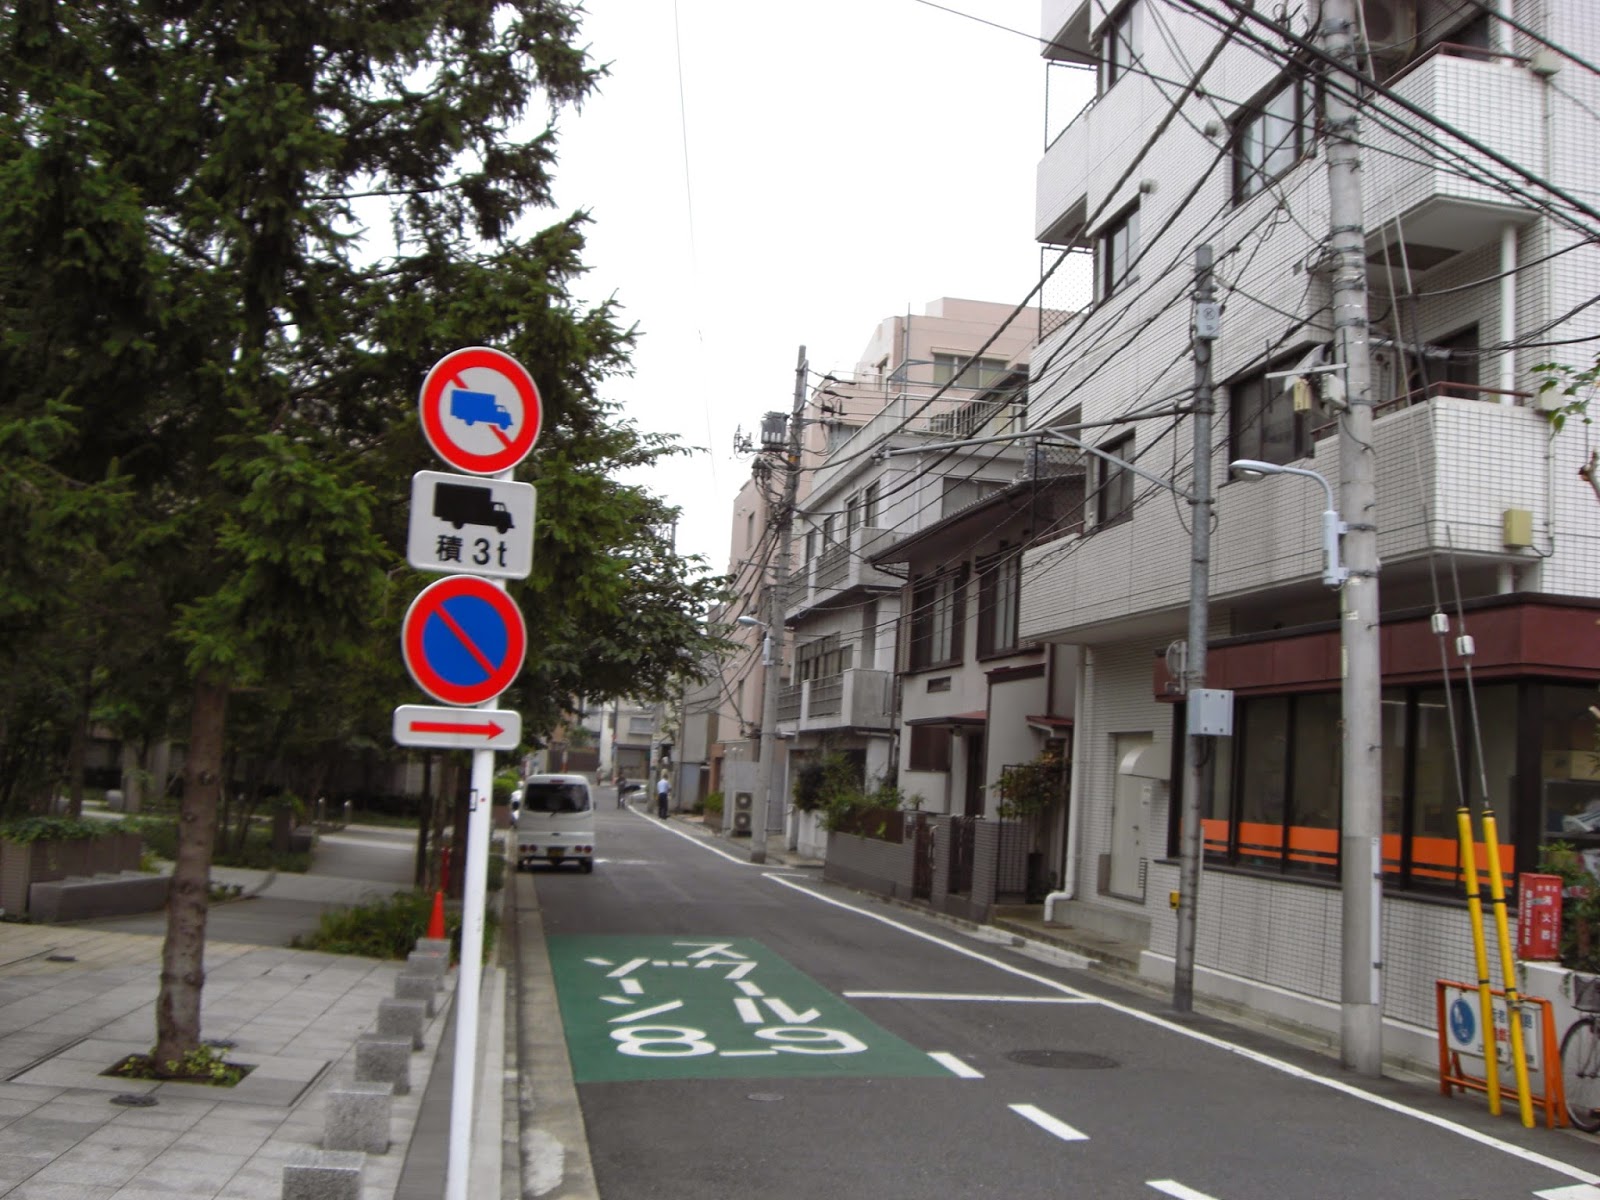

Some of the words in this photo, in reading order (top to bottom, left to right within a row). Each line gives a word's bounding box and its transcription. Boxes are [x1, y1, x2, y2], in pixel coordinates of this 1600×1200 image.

[584, 958, 688, 1023] ゾーン
[672, 942, 821, 1024] スクール
